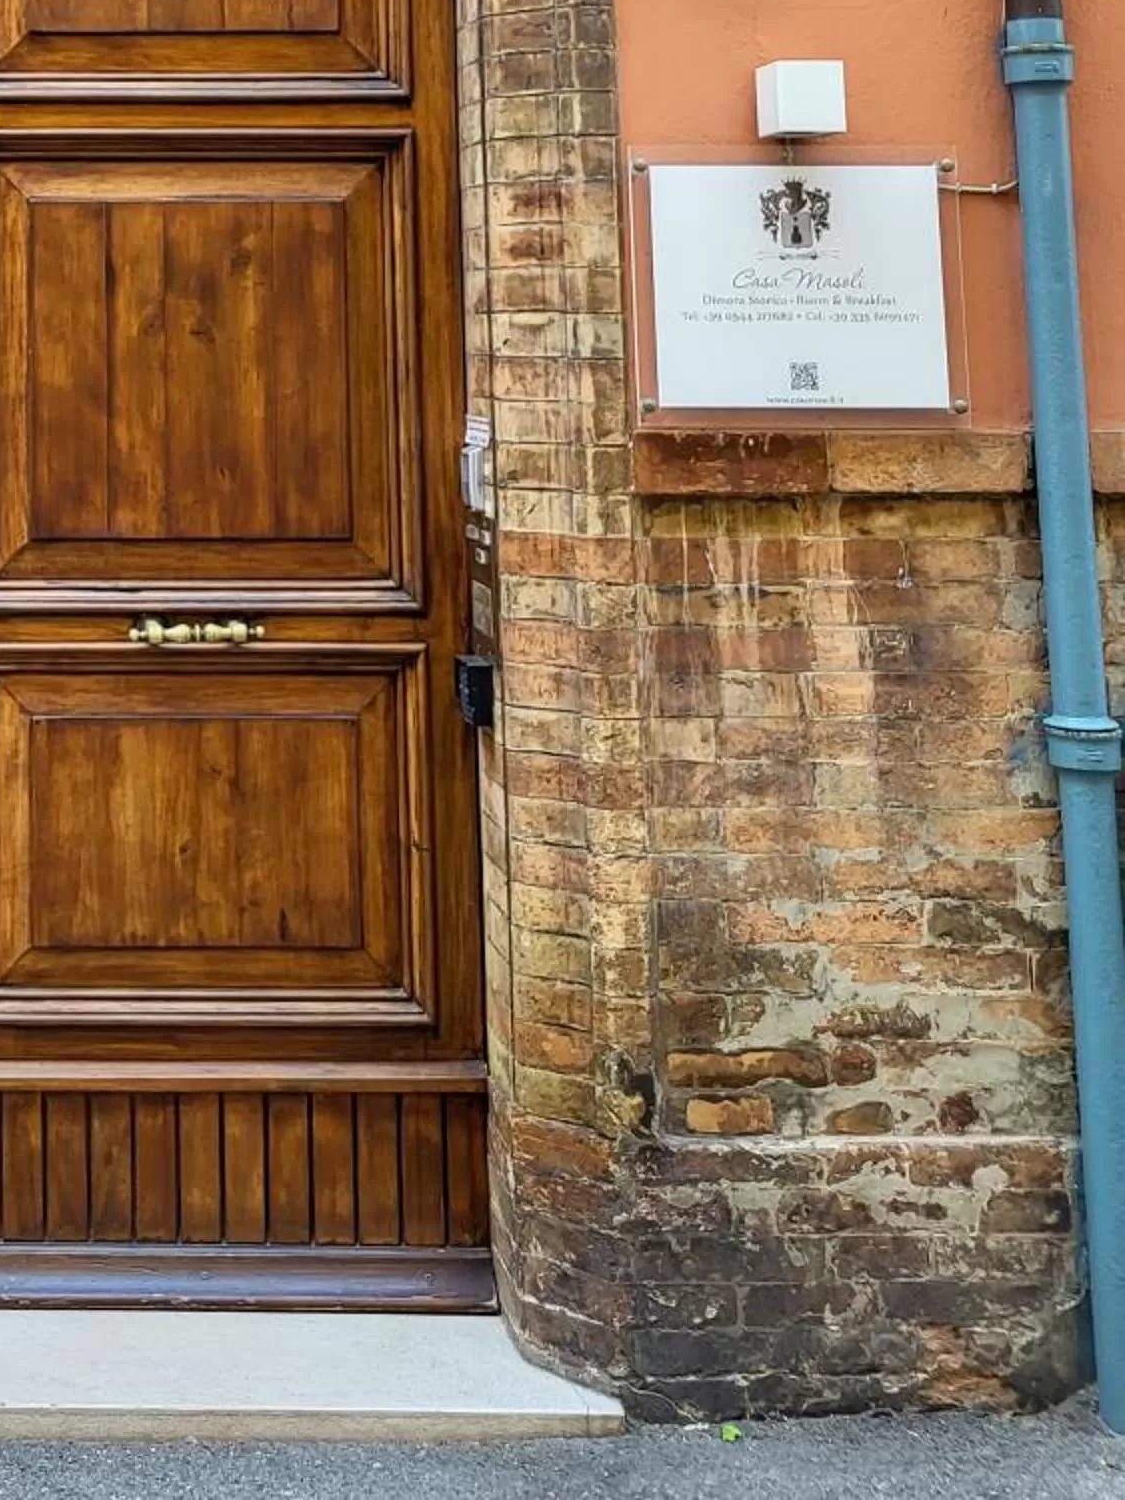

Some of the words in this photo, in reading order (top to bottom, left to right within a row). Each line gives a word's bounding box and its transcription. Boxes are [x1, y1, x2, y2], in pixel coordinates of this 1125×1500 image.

[732, 268, 780, 290] Casa
[782, 266, 865, 290] Masoli
[702, 295, 746, 306] Dimora
[796, 295, 830, 306] Room
[832, 295, 842, 306] &
[844, 294, 896, 306] Breakfast
